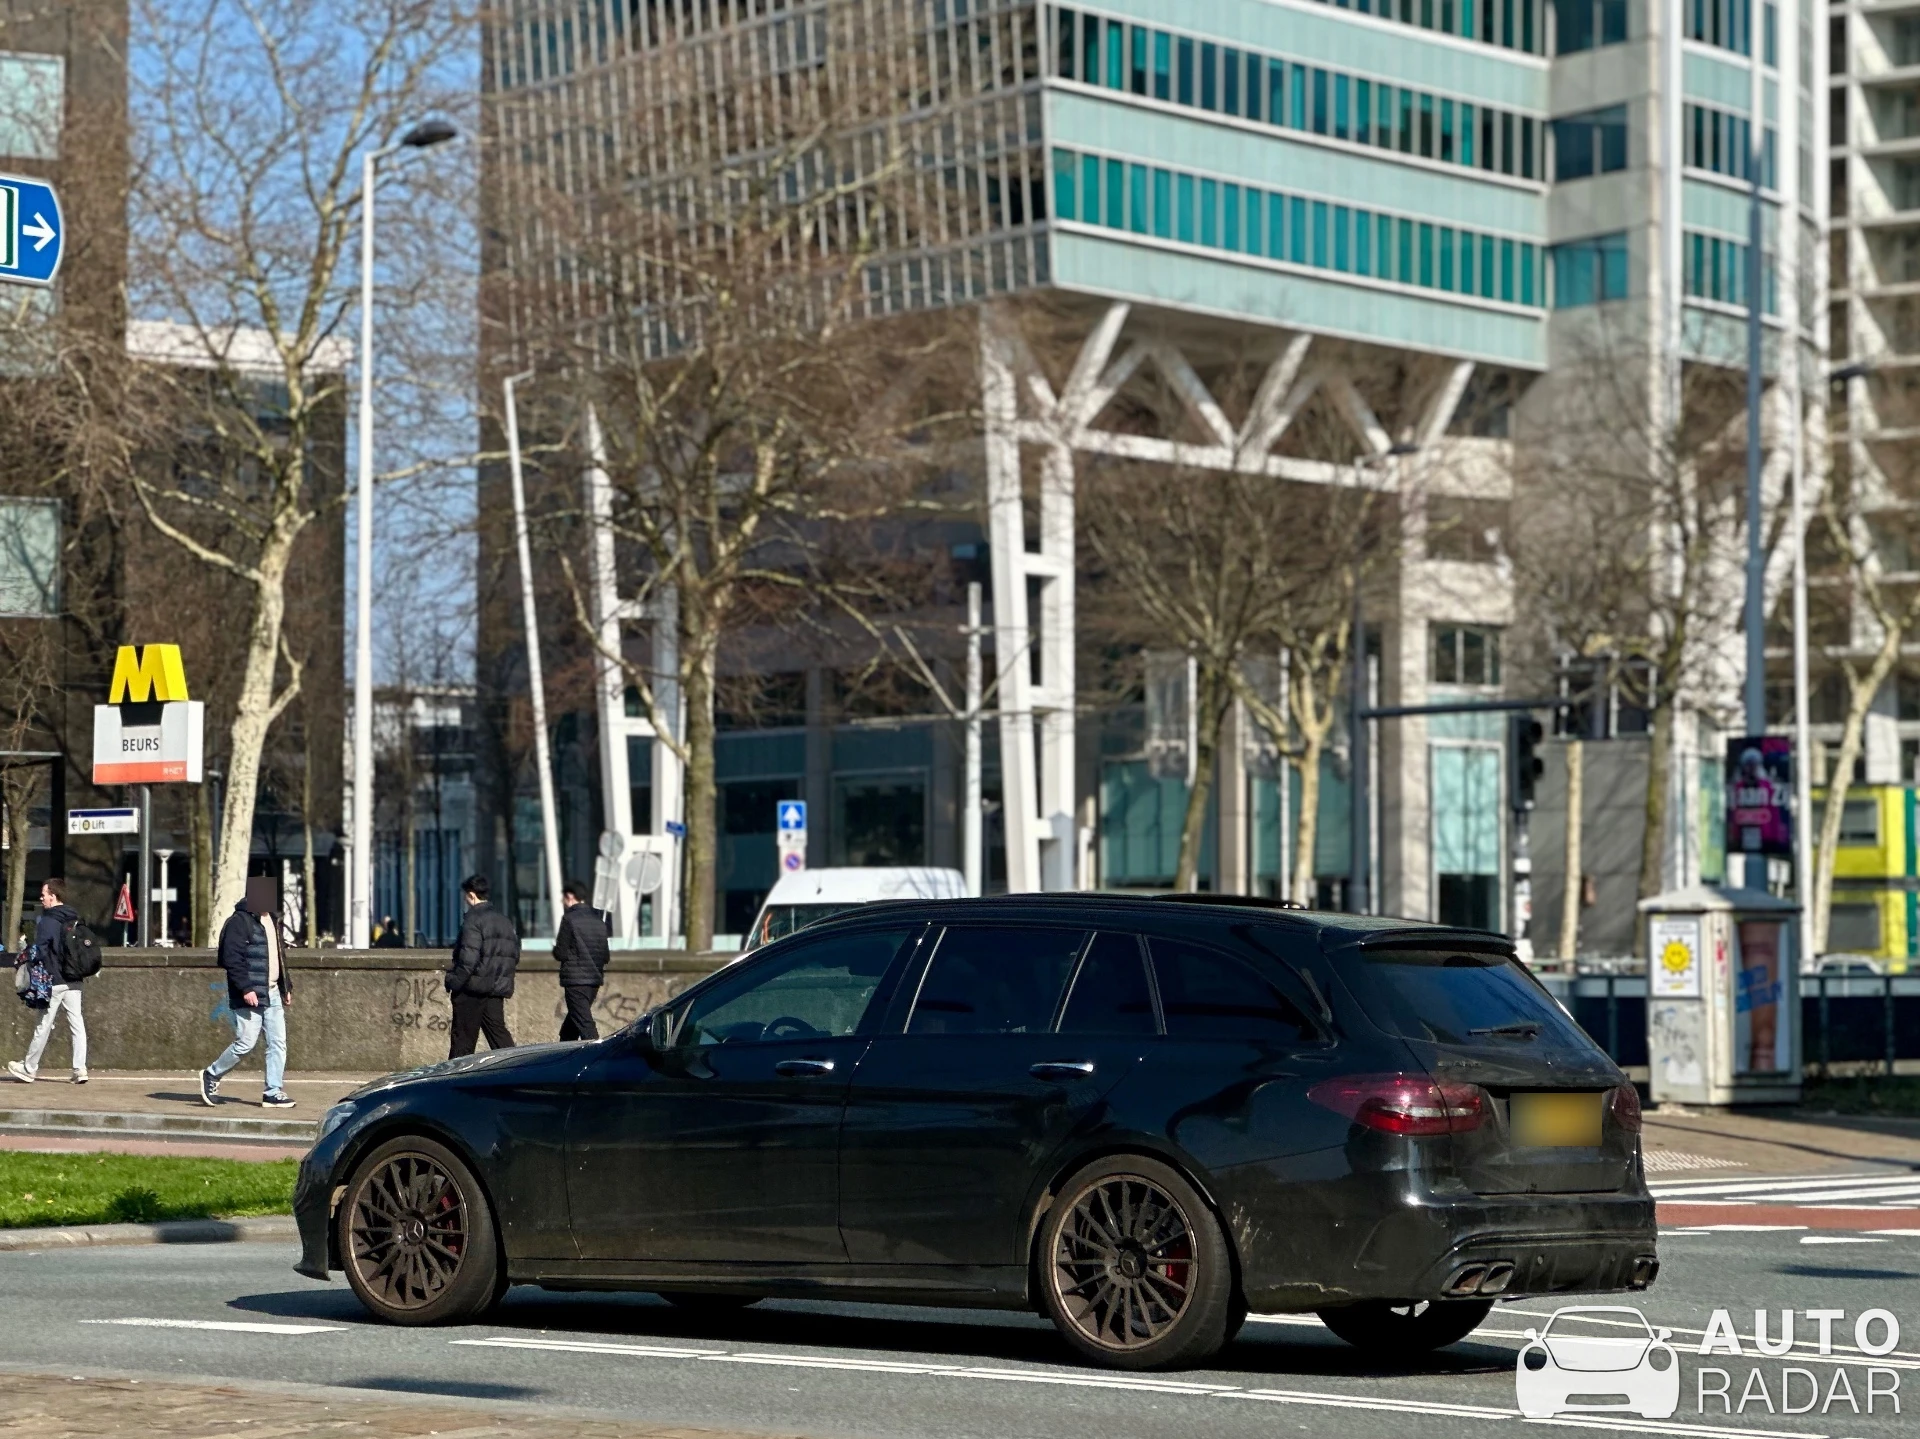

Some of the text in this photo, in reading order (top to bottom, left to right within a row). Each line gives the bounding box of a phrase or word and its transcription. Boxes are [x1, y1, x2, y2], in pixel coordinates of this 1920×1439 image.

[108, 643, 185, 703] M
[121, 738, 160, 752] BEURS
[91, 820, 105, 830] Lift
